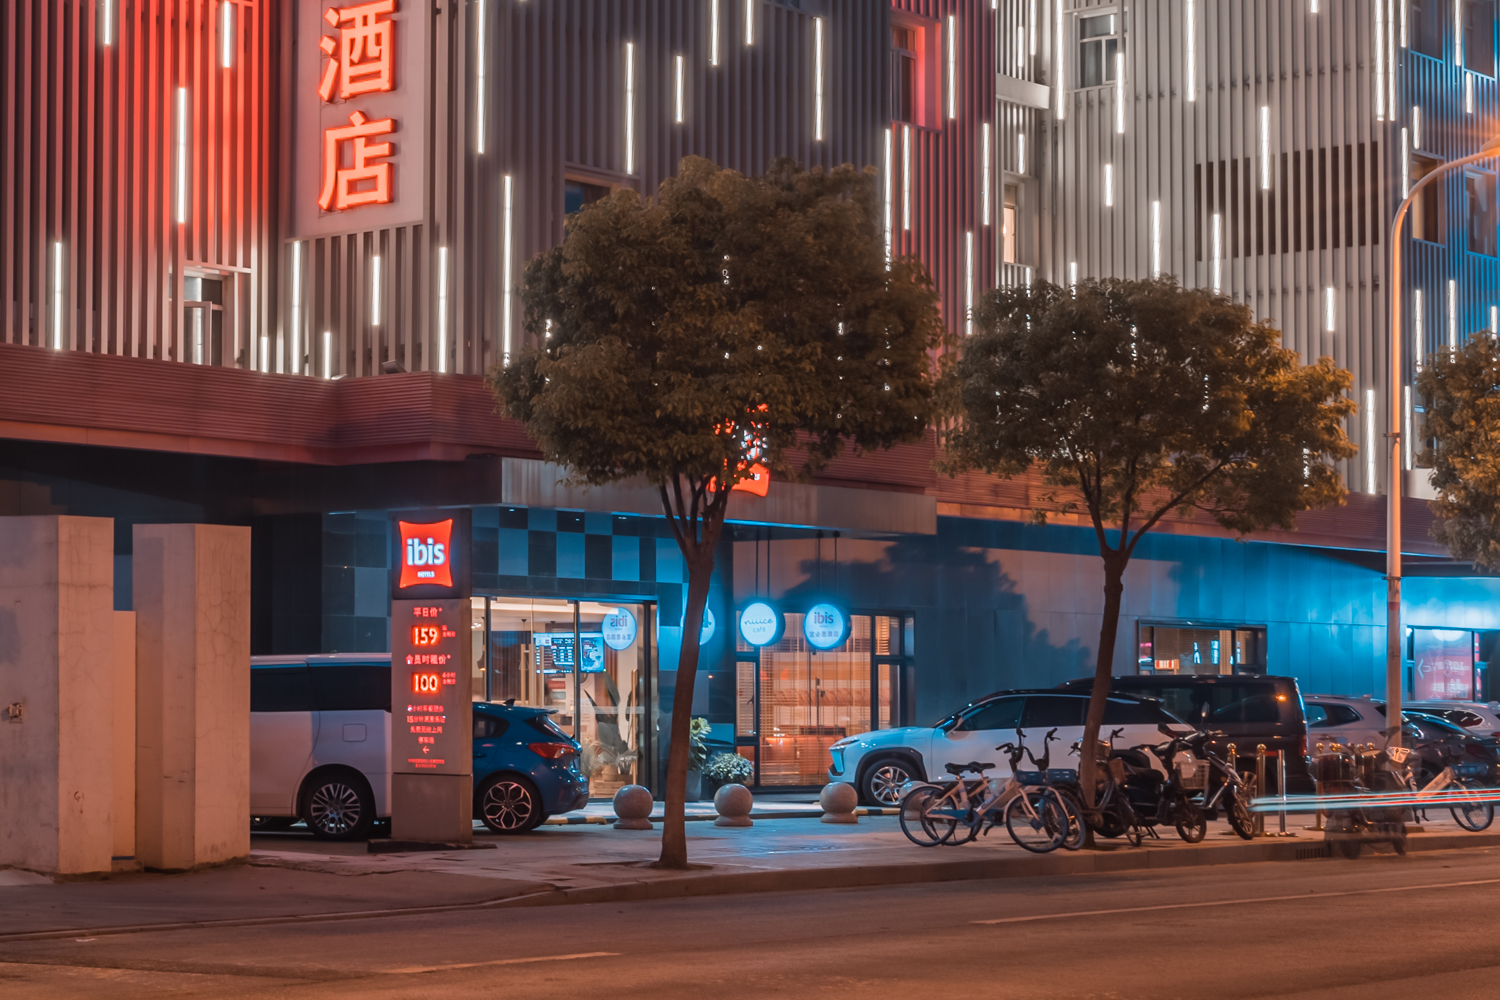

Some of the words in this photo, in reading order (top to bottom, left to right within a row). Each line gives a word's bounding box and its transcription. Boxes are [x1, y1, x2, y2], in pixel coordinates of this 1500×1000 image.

[406, 537, 446, 566] ibis
[813, 611, 834, 625] ibis
[414, 627, 438, 645] 159
[414, 675, 438, 692] 100
